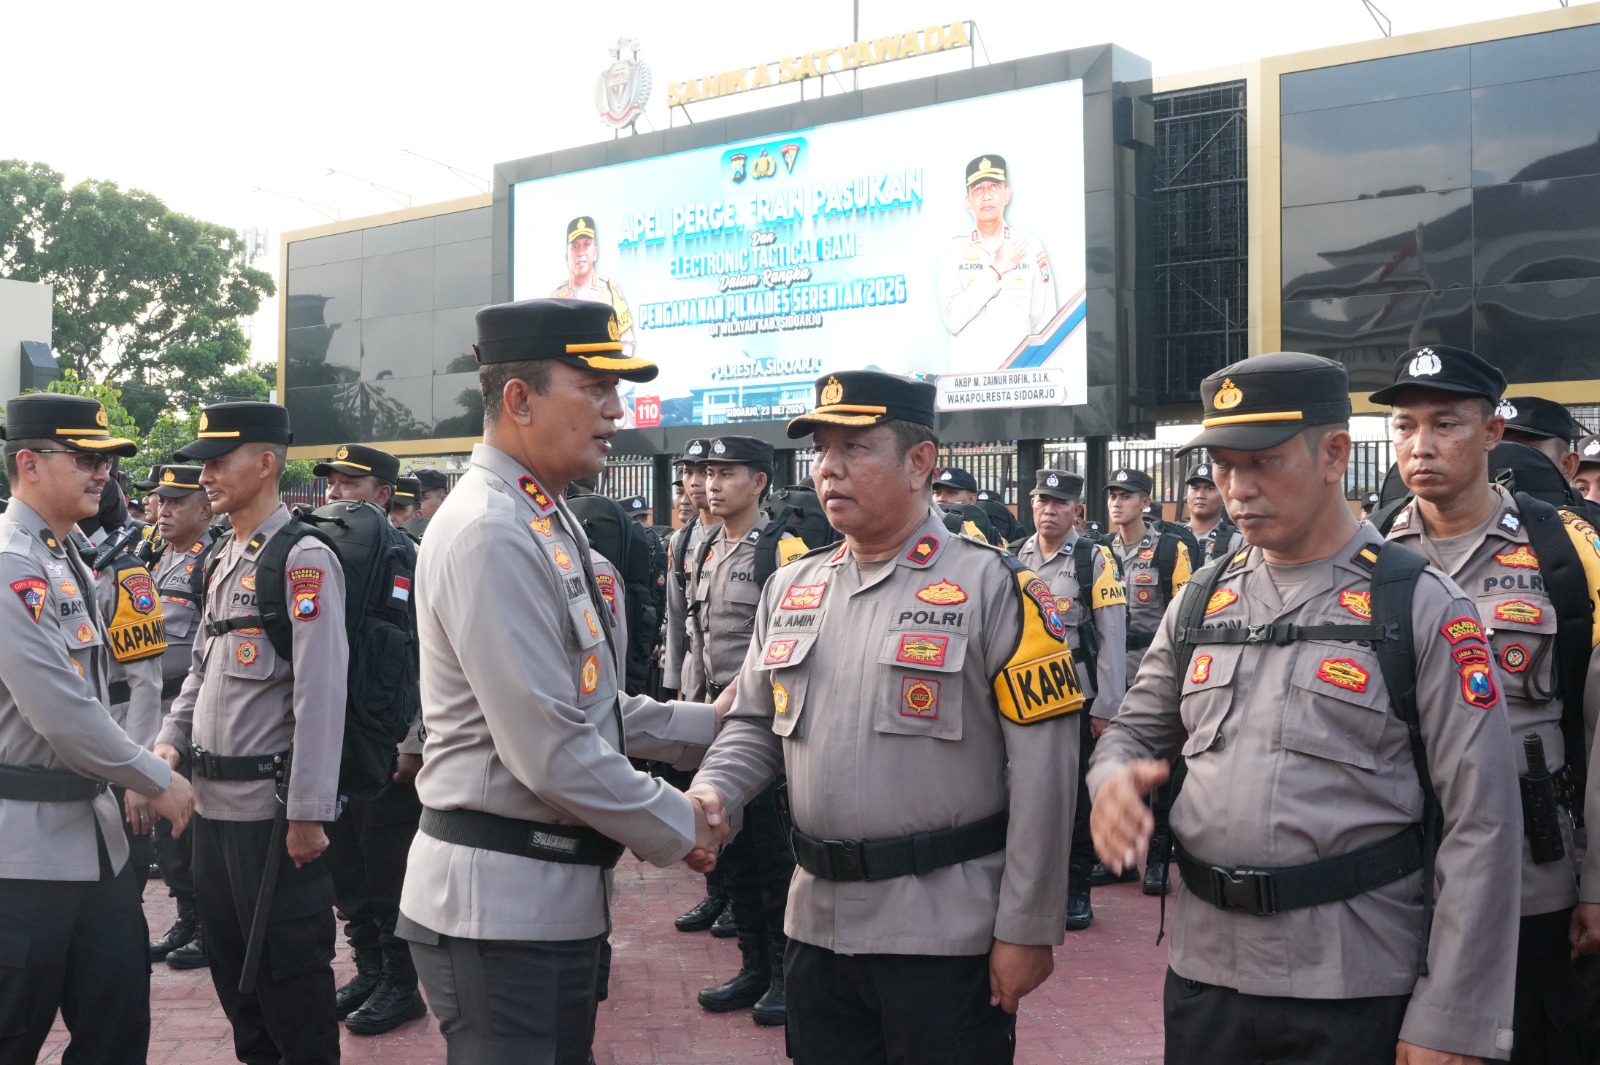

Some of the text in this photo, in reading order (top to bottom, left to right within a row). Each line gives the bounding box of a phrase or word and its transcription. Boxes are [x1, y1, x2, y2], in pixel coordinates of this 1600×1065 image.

[666, 20, 968, 107] SANIKA SATYAWADA
[618, 208, 665, 247] APEL
[812, 167, 923, 220] PASUKAN
[751, 231, 777, 247] Dan
[669, 233, 863, 279] ELECTRONIC TACTICAL GAME
[719, 266, 812, 292] Dalam Rangka
[639, 295, 725, 330] PENGAMANAN
[726, 287, 791, 321] PILKADES
[792, 279, 864, 314] SERENTAK
[865, 274, 907, 307] 2026
[720, 317, 758, 337] WILAYAH
[780, 312, 823, 331] SIDOARJO
[711, 358, 822, 380] POLRESTA SIDOARJO
[954, 377, 972, 388] AKBP
[983, 375, 1007, 386] ZAINUR
[1008, 373, 1031, 385] ROFIK,
[947, 388, 1055, 404] WAKAPOLRESTA SIDOARJO
[637, 403, 659, 420] 110
[726, 404, 805, 418] SIDOARJO, 23 MEI 2026
[232, 592, 258, 606] POL
[773, 614, 816, 628] M. AMIN
[898, 610, 963, 627] POLRI
